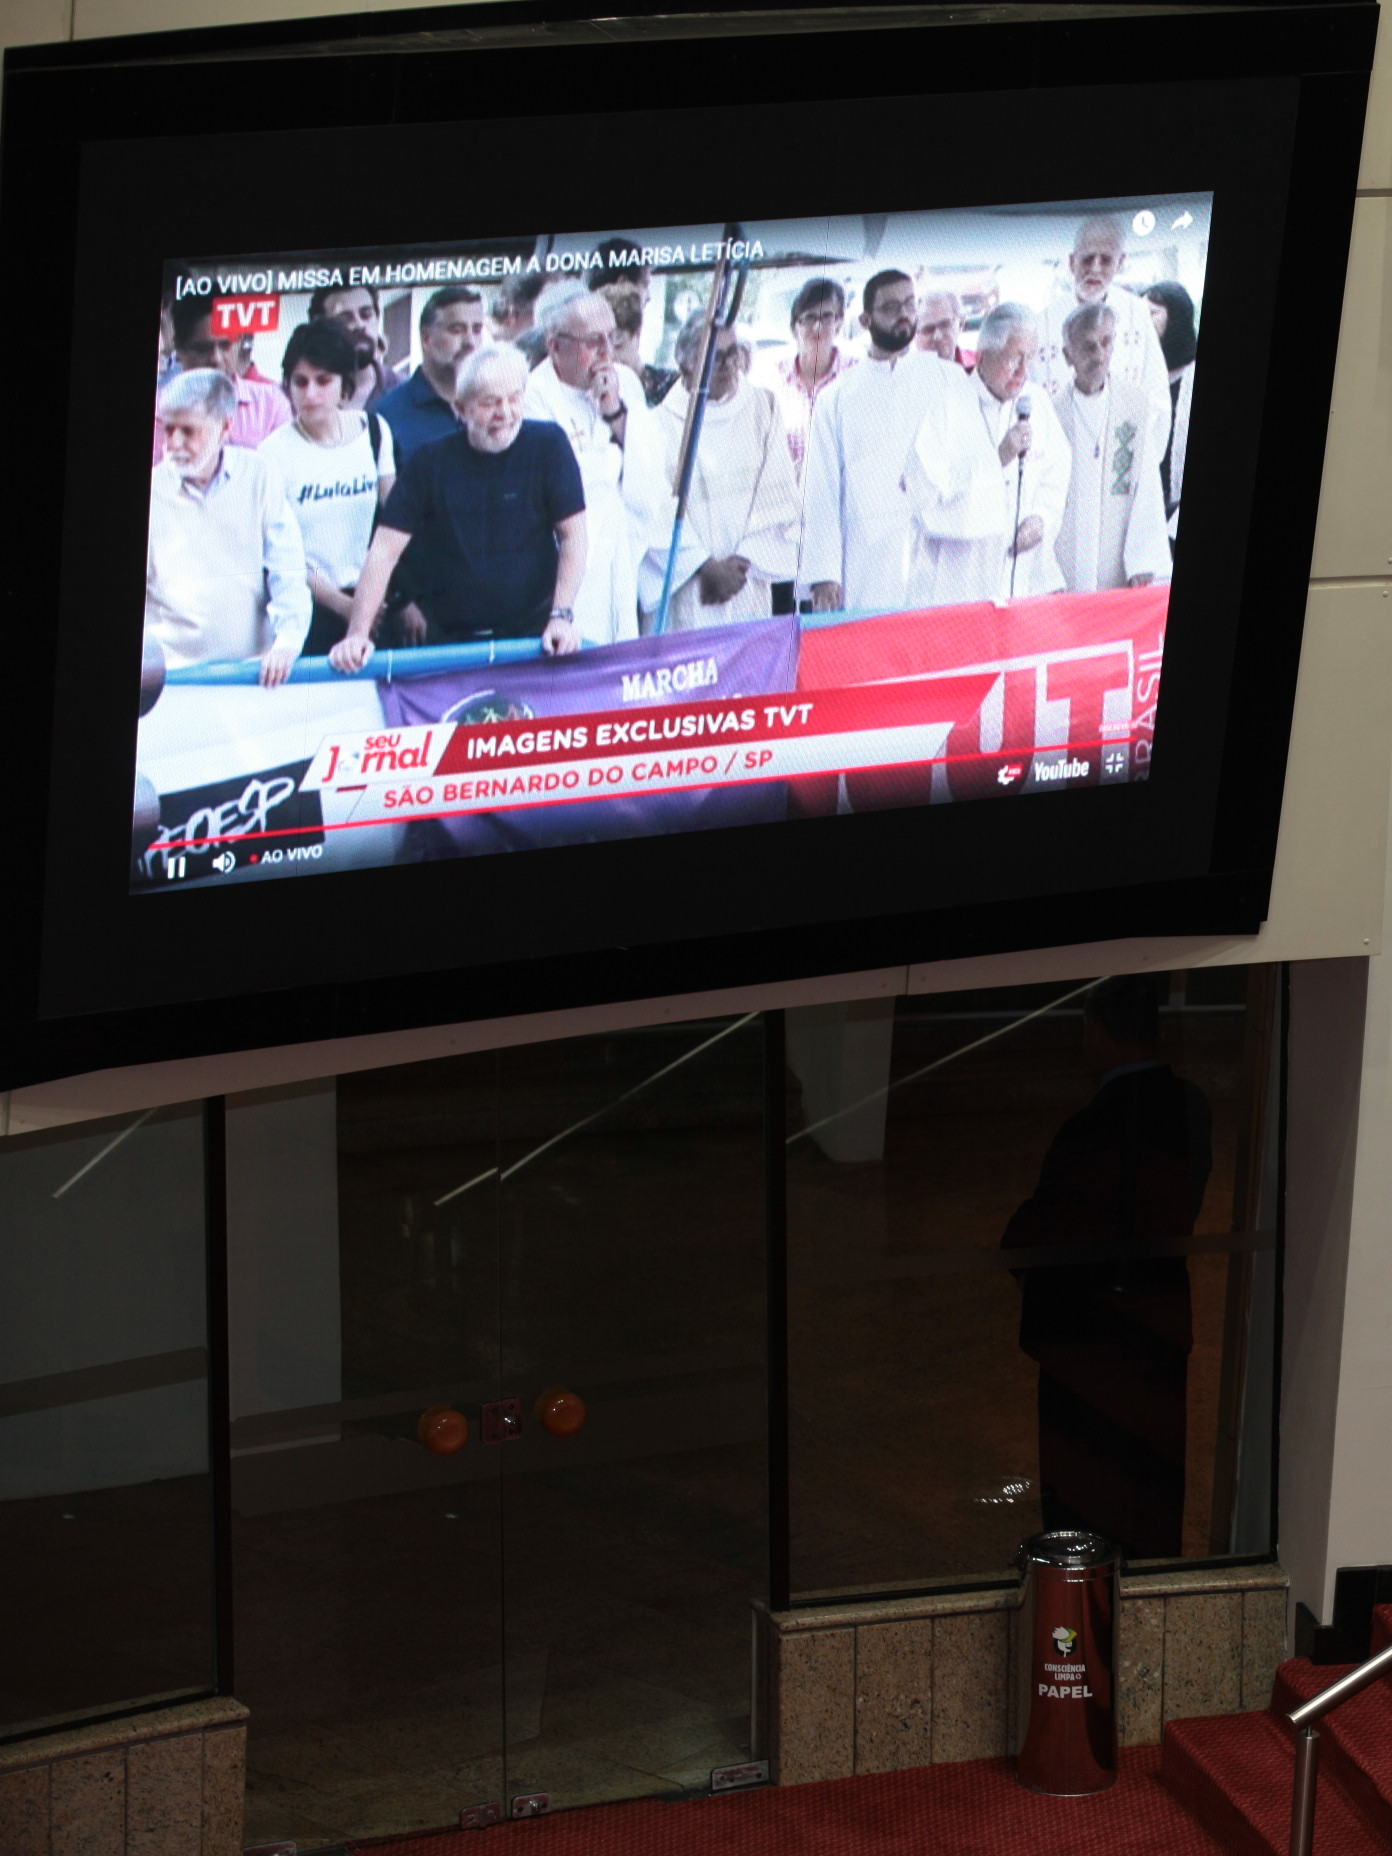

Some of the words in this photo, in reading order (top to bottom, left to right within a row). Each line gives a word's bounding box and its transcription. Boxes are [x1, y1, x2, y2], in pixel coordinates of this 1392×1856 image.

[175, 275, 212, 299] [AO
[217, 270, 272, 294] VIVO]
[277, 267, 343, 291] MISSA
[349, 265, 380, 285] EM
[385, 254, 521, 283] HOMENAGEM
[526, 254, 541, 273] A
[546, 251, 603, 272] DONA
[608, 244, 685, 268] MARISA
[690, 237, 764, 262] LETÍCIA
[216, 301, 276, 329] TVT
[621, 658, 718, 702] MARCHA
[365, 734, 401, 750] seu
[467, 727, 588, 760] IMAGENS
[595, 709, 756, 746] EXCLUSIVAS
[763, 703, 813, 727] TVT
[384, 786, 433, 808] SÃO
[443, 766, 579, 802] BERNARDO
[588, 766, 623, 783] DO
[632, 755, 718, 780] CAMPO
[744, 750, 773, 769] SP
[1034, 758, 1090, 782] YouTube
[261, 850, 283, 864] AO
[286, 845, 323, 860] VIVO
[1044, 1663, 1086, 1672] CONSCIÊNCIA
[1054, 1673, 1075, 1681] LIMPA
[1038, 1683, 1093, 1699] PAPEL
